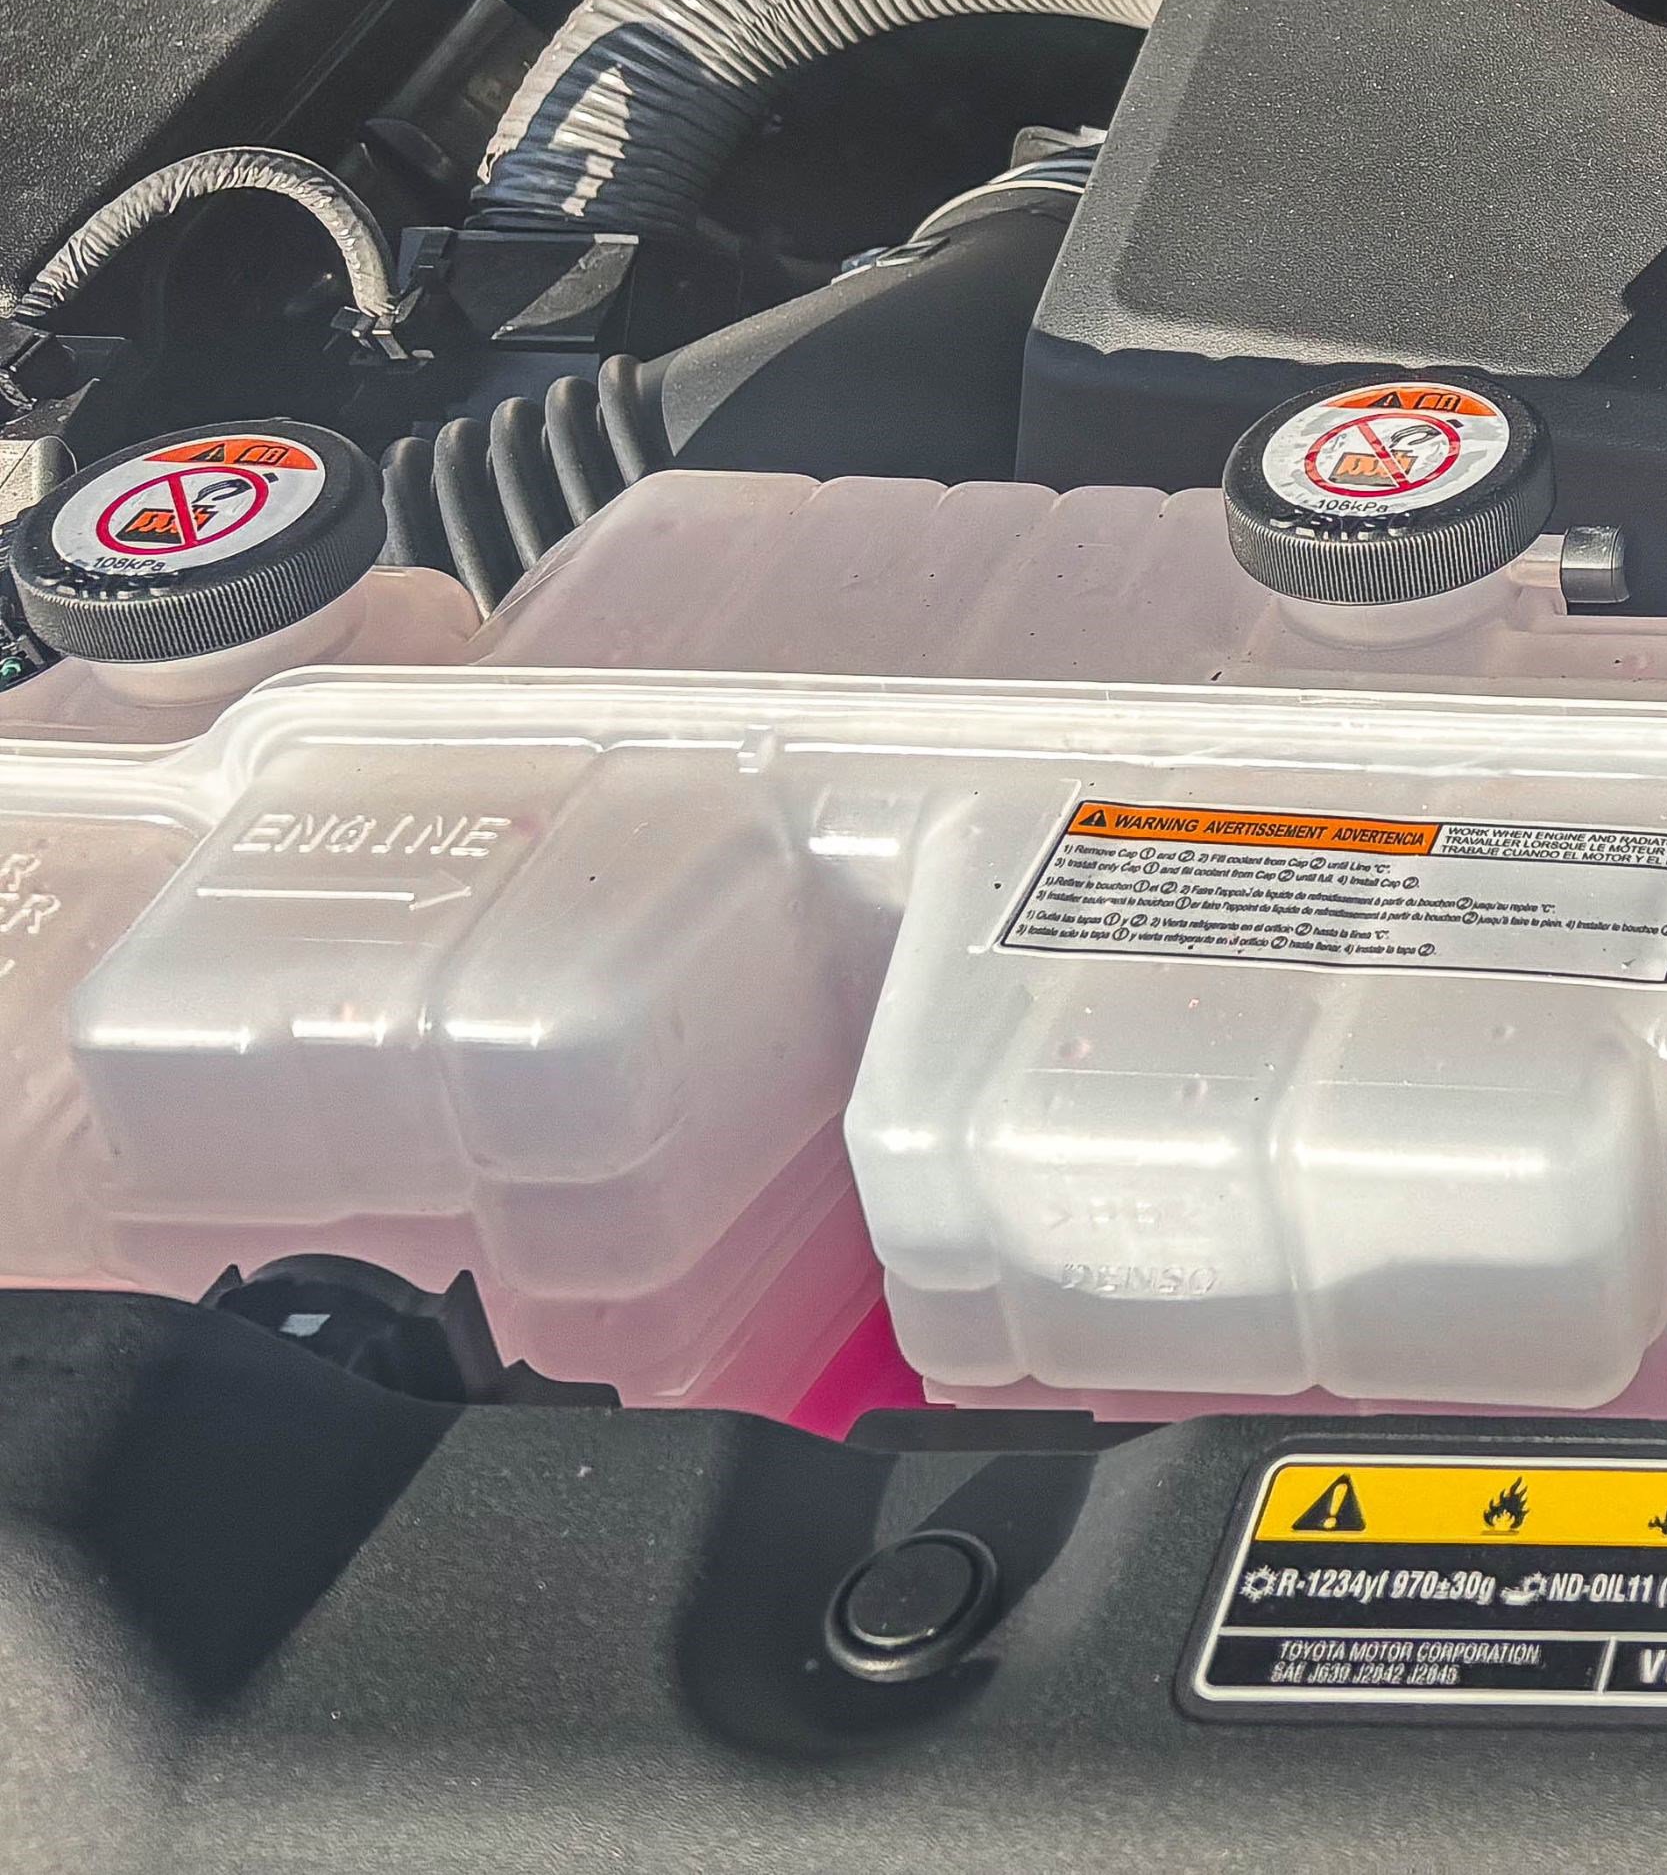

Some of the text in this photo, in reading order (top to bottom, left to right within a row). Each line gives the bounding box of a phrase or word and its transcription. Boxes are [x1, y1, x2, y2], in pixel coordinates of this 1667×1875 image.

[232, 813, 511, 857] ENGINE
[1114, 813, 1424, 846] WARNING AVERTISSEMENT ADVERTENCIA
[1445, 834, 1521, 848] TRAVAILLER
[1522, 839, 1586, 851] LORSQUE
[1588, 842, 1606, 853] LE
[1447, 826, 1490, 837] WORK
[1491, 828, 1533, 839] WHEN
[1534, 830, 1585, 842] ENGINE
[1586, 833, 1617, 844] AND
[1073, 843, 1116, 857] Remove
[1116, 847, 1138, 860] Cap
[1155, 851, 1177, 861] and
[1262, 856, 1287, 866] from
[1286, 857, 1309, 869] Cap
[1348, 861, 1372, 873] Line
[1441, 843, 1500, 856] TRABAJE
[1501, 847, 1560, 859] CUANDO
[1561, 850, 1578, 860] EL
[1581, 851, 1632, 863] MOTOR
[1634, 854, 1645, 863] Y
[1645, 854, 1662, 865] EL
[1096, 862, 1120, 873] only
[1119, 860, 1142, 874] Cap
[1158, 865, 1181, 875] and
[1230, 868, 1254, 879] from
[1254, 869, 1277, 881] Cap
[1379, 877, 1401, 889] Cap
[1275, 1567, 1392, 1605] R-1234yf
[1391, 1569, 1497, 1606] 970±30g
[1548, 1572, 1655, 1603] ND-OIL11
[1279, 1639, 1543, 1666] TOYOTA MOTOR CORPORATION
[1269, 1661, 1305, 1684] SAE
